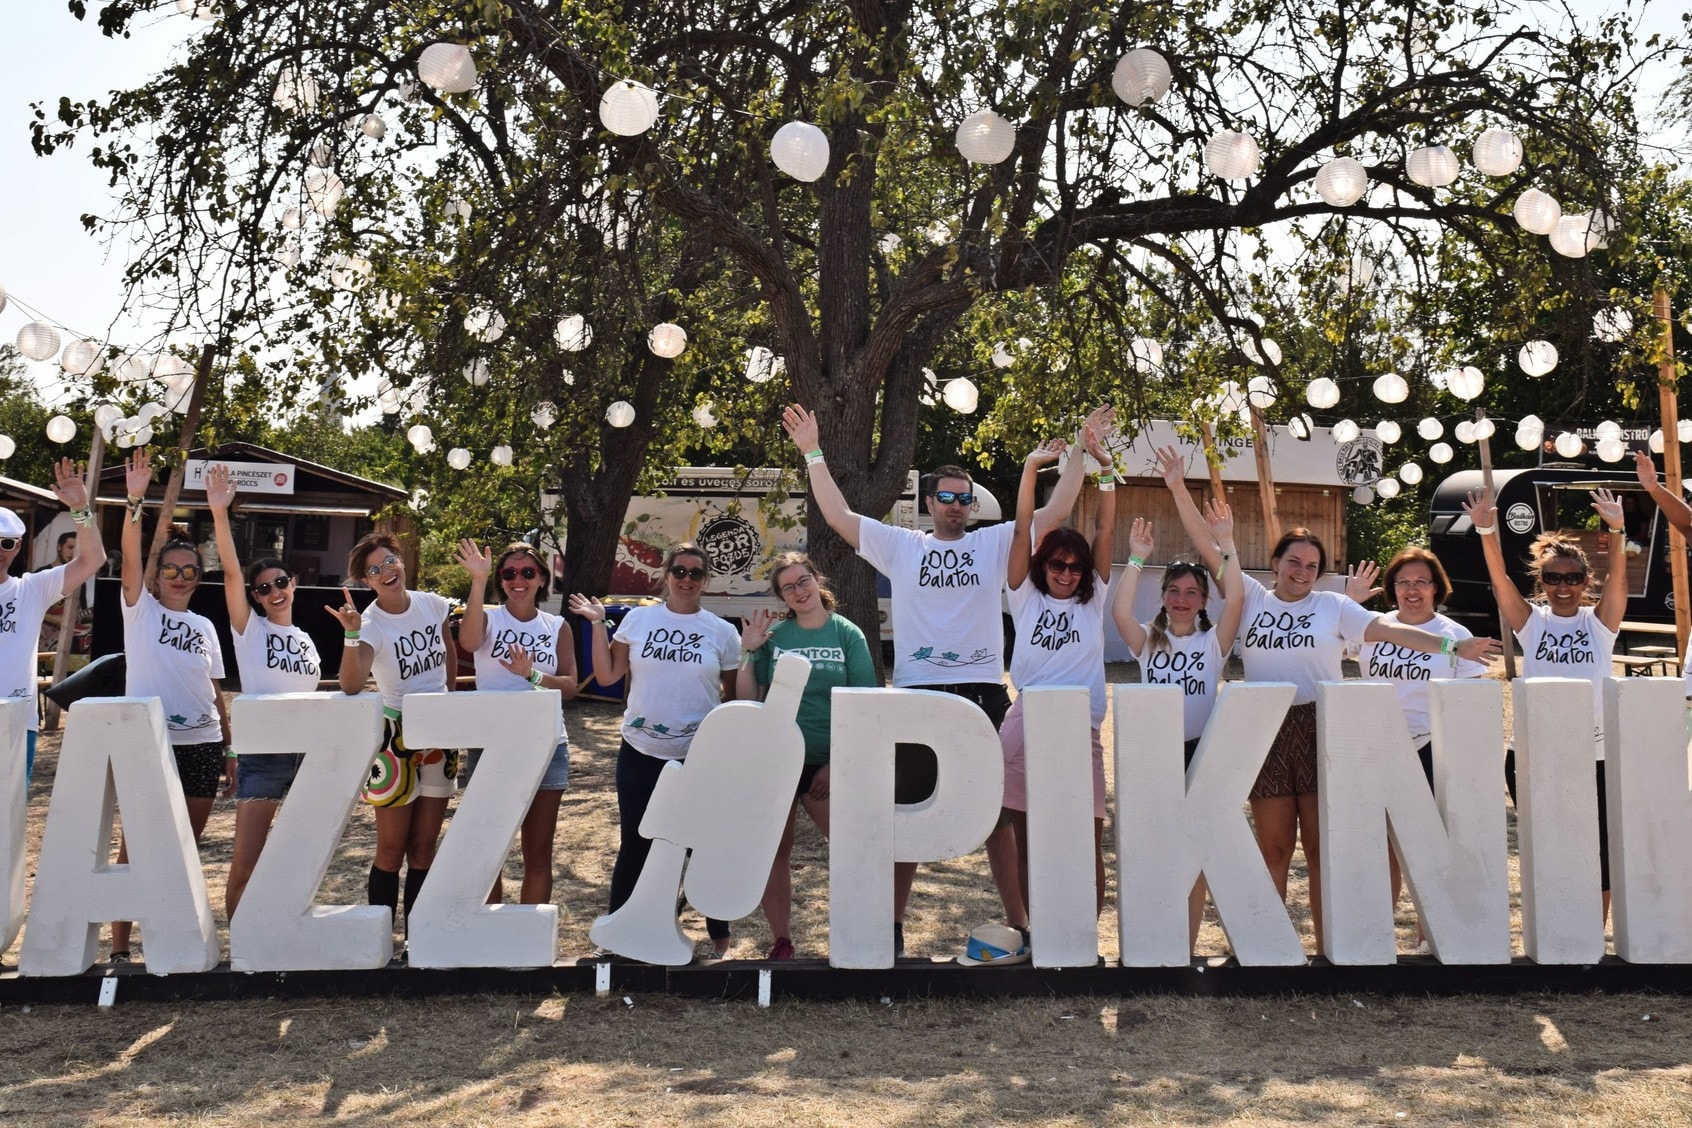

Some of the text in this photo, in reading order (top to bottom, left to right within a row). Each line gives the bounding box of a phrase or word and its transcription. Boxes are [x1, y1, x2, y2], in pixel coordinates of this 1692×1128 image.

[1177, 436, 1253, 448] TAITINGE
[1619, 429, 1648, 440] ISTRO
[706, 526, 745, 542] LEGENDA
[921, 548, 976, 570] 100%
[919, 566, 980, 588] Balaton
[1251, 611, 1316, 631] 100%
[394, 624, 441, 659] 100%
[496, 629, 552, 648] 100%
[647, 628, 704, 648] 100%
[1245, 627, 1315, 650] Balaton
[641, 641, 702, 664] Balaton
[777, 649, 841, 660] NTOR
[1147, 650, 1205, 672] 100%
[1536, 640, 1595, 664] Balaton
[1369, 655, 1431, 681] Balaton
[0, 690, 561, 978] AZZ
